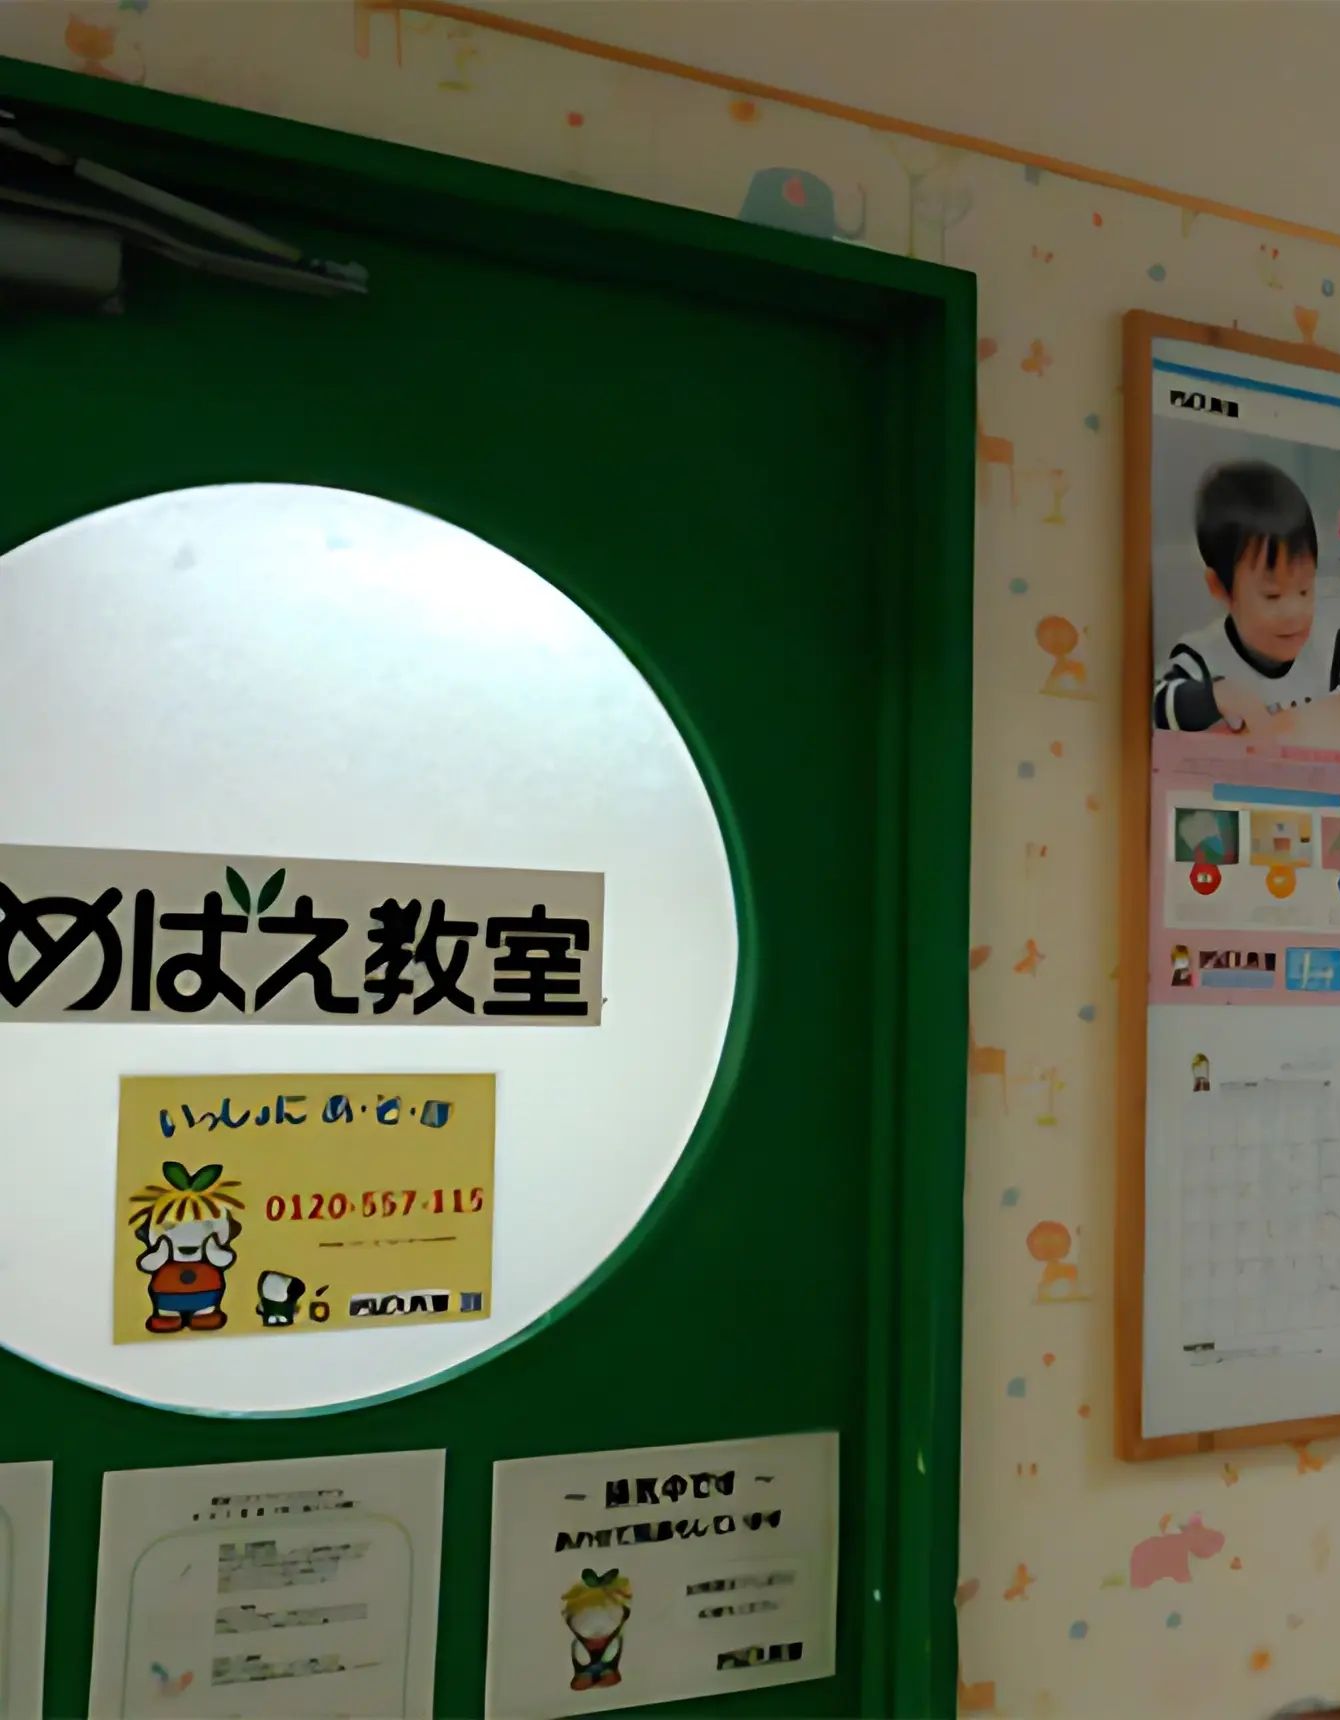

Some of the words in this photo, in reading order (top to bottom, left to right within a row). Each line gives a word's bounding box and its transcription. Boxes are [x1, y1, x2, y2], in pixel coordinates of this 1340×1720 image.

[0, 866, 590, 1016] めばえ教室
